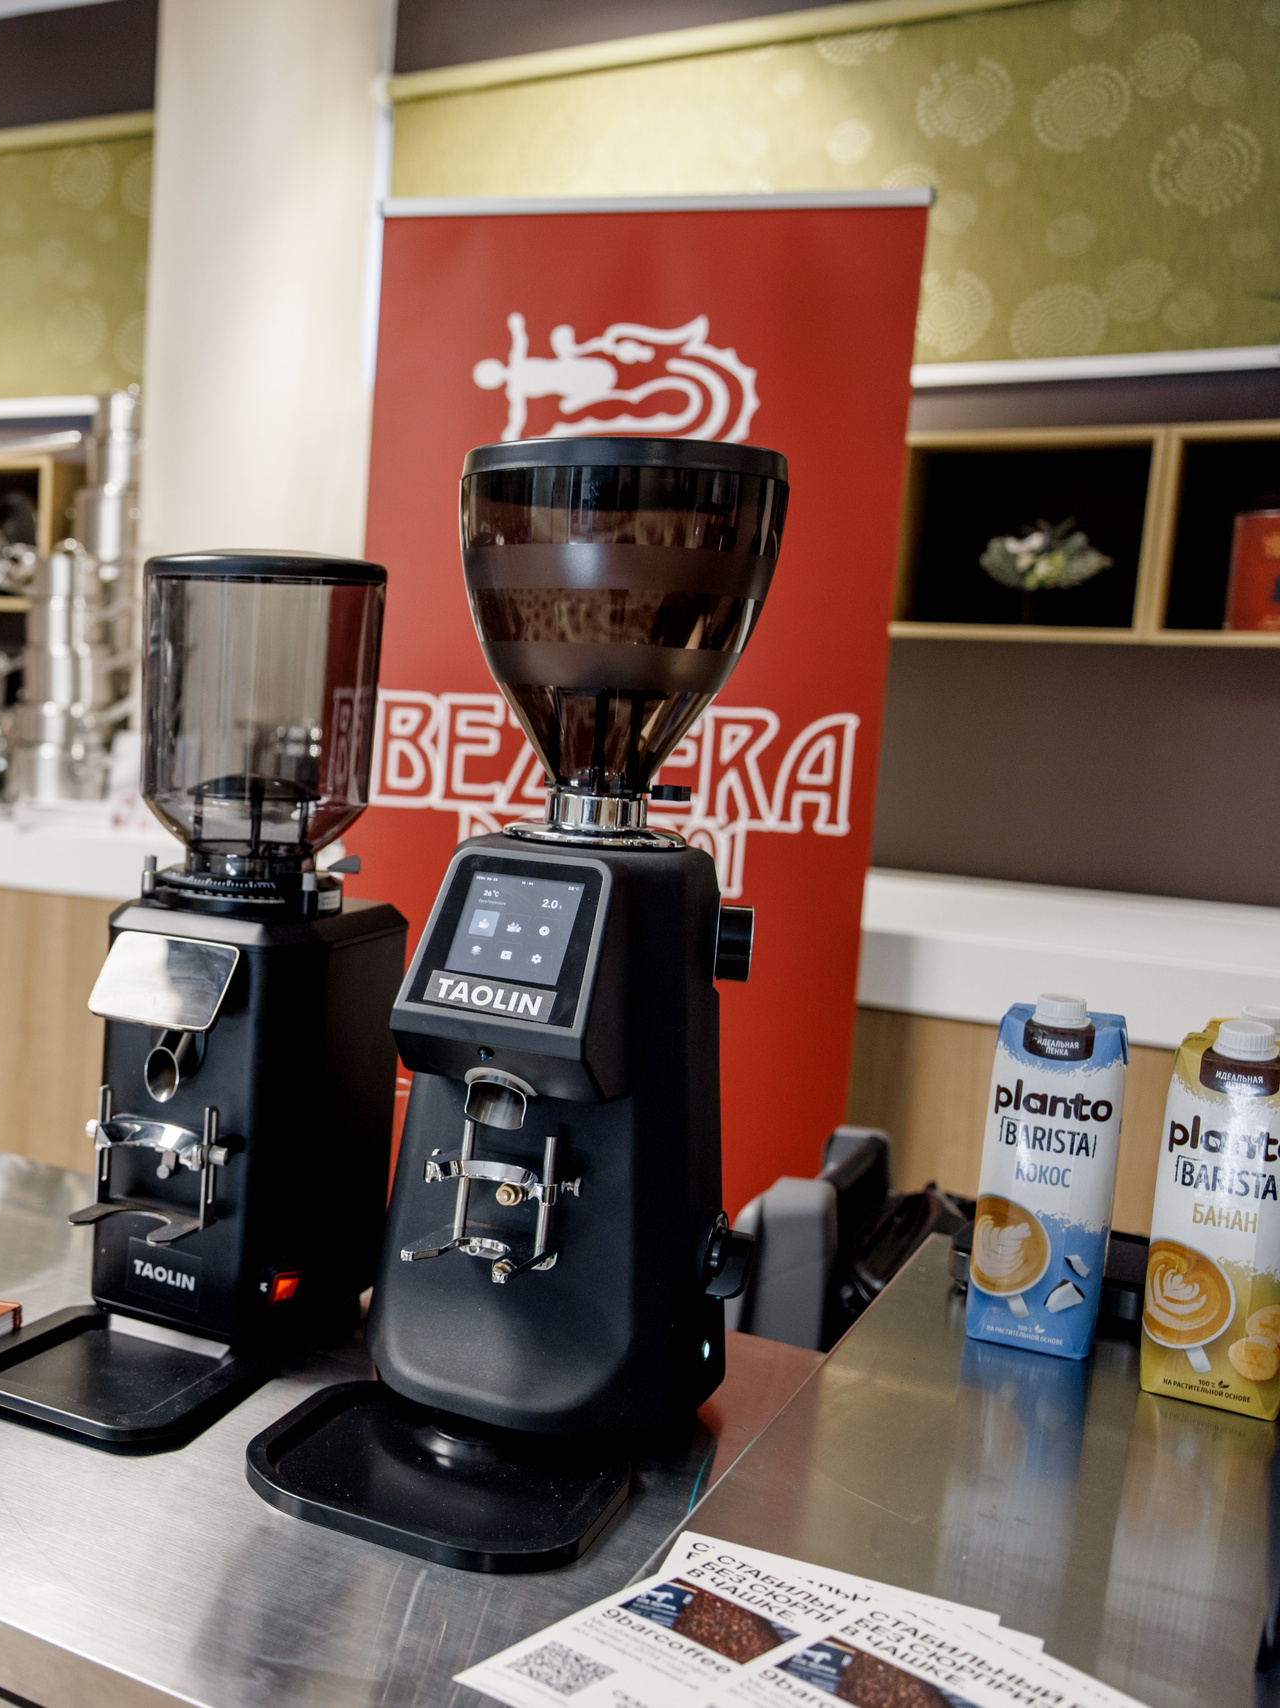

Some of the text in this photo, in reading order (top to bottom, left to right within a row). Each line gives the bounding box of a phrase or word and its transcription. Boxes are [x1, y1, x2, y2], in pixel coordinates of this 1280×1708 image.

[541, 898, 559, 910] 2.0
[438, 977, 543, 1016] TAOLIN
[1036, 1037, 1080, 1050] ИДЕАЛЬНАЯ
[1045, 1047, 1069, 1057] ПЕНКА
[1215, 1070, 1264, 1084] ИДЕАЛЬНАЯ
[994, 1078, 1113, 1122] planto
[1005, 1121, 1090, 1157] BARISTA
[1168, 1115, 1280, 1162] plant
[1015, 1161, 1072, 1188] КОКОС
[1180, 1160, 1278, 1201] BARISTA
[1192, 1202, 1258, 1234] БАНАН
[133, 1259, 196, 1292] TAOLIN
[995, 1326, 1039, 1342] РАСТИТЕЛЬНОЙ
[1040, 1336, 1063, 1347] ОСНОВЕ
[1163, 1378, 1251, 1404] НА РАСТИТЕЛЬНОЙ ОСНОВЕ
[1199, 1379, 1210, 1387] 100
[686, 1568, 706, 1579] В
[701, 1561, 747, 1584] БЕЗ
[602, 1608, 732, 1675] 9barcoffee
[840, 1625, 860, 1636] В
[854, 1618, 905, 1643] БЕЗ
[869, 1610, 1064, 1704] СТАБИЛЬНЫЙ
